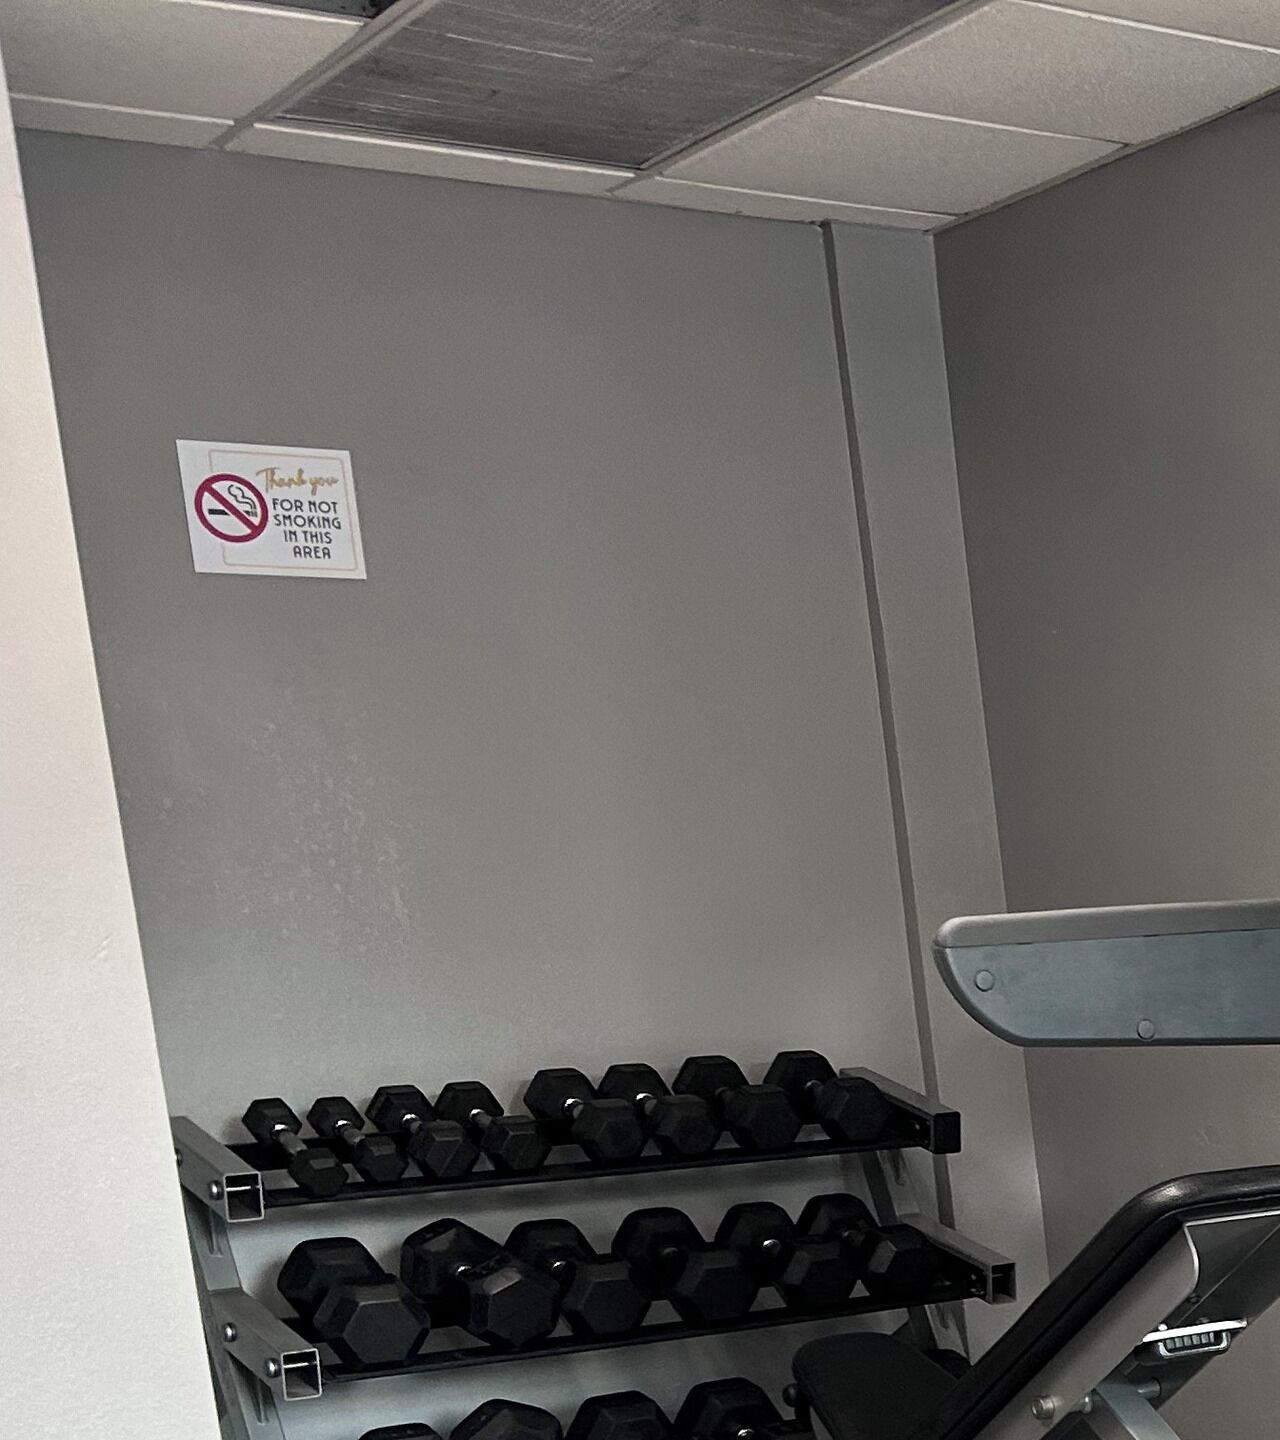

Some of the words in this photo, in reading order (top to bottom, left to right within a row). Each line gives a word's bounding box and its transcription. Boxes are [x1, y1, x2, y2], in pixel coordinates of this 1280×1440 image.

[256, 467, 306, 493] Thank
[309, 476, 339, 496] you
[272, 498, 303, 513] FOR
[308, 500, 338, 514] NOT
[274, 514, 342, 530] SMOKING
[283, 530, 298, 544] IN
[302, 531, 332, 544] THIS
[293, 546, 331, 559] AREA
